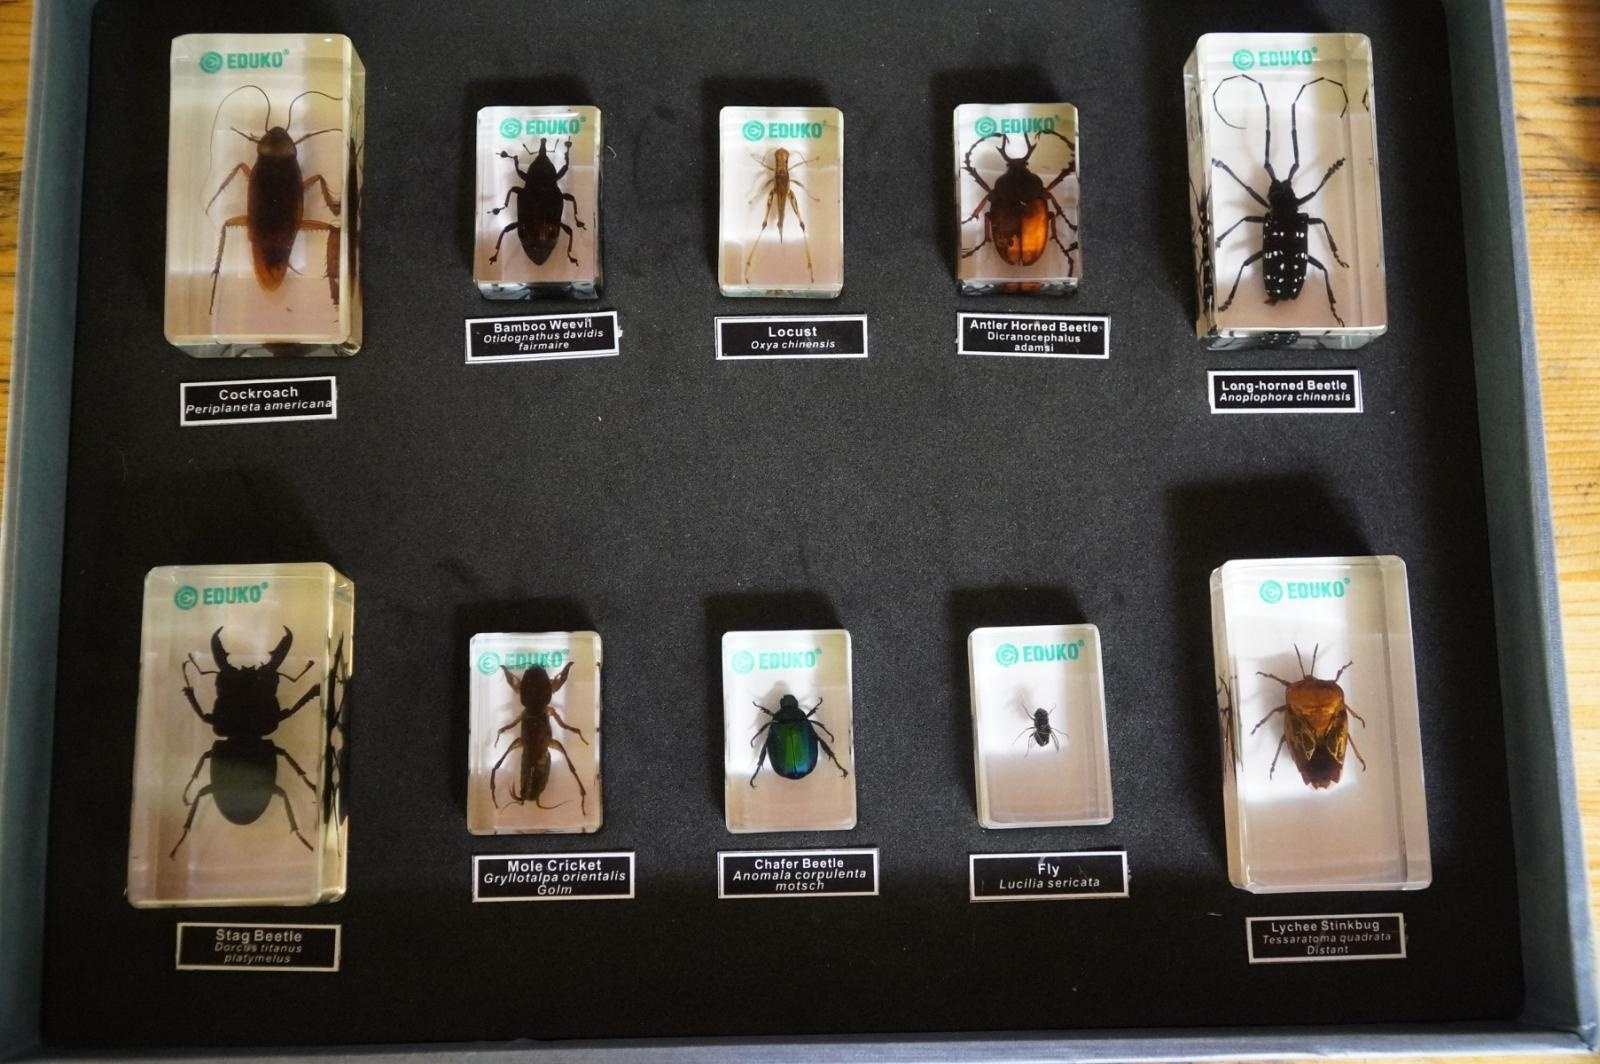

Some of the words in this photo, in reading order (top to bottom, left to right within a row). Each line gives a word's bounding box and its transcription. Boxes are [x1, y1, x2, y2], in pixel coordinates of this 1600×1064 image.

[227, 52, 283, 69] EDUKO
[1258, 49, 1312, 67] EDUKO
[526, 119, 580, 135] EDUKO
[768, 122, 822, 138] EDUKO
[1001, 117, 1055, 134] EDUKO
[493, 322, 547, 333] Bamboo
[549, 318, 592, 330] Weevil
[768, 326, 817, 337] Locust
[970, 319, 1008, 330] Antler
[1011, 320, 1056, 331] Horned
[1059, 321, 1098, 333] Beetle
[483, 330, 560, 344] Otidognathus
[563, 329, 604, 339] davidis
[987, 331, 1081, 343] Dicranocephalus
[518, 341, 569, 351] fairmaire
[751, 340, 779, 350] Oxya
[781, 339, 835, 349] chinensis
[1014, 343, 1054, 352] adamsi
[219, 386, 299, 400] Cockroach
[1222, 380, 1304, 392] Long-horned
[1307, 380, 1347, 390] Beetle
[1219, 392, 1293, 403] Anoplophora
[1296, 391, 1351, 401] chinensis
[185, 402, 261, 415] Periplaneta
[264, 399, 332, 411] americana
[203, 585, 261, 605] EDUKO
[1287, 580, 1344, 600] EDUKO
[1023, 643, 1079, 662] EDUKO
[505, 651, 563, 669] EDUKO
[759, 651, 816, 669] EDUKO
[507, 860, 543, 872] Mole
[547, 859, 602, 871] Cricket
[754, 859, 799, 869] Chafer
[802, 858, 844, 868] Beetle
[1037, 863, 1060, 877] Fly
[484, 872, 559, 886] Gryllotalpa
[562, 871, 626, 882] orientalis
[733, 870, 791, 881] Anomala
[795, 869, 867, 882] corpulenta
[537, 884, 572, 895] Golm
[775, 880, 824, 891] motsch
[1000, 879, 1044, 889] Lucilia
[1047, 877, 1100, 888] sericata
[1271, 922, 1317, 935] Lychee
[1320, 920, 1380, 932] Stinkbug
[215, 929, 250, 944] Stag
[254, 929, 302, 942] Beetle
[1263, 934, 1336, 944] Tessaratoma
[1340, 932, 1391, 944] quadrata
[214, 942, 257, 952] Dorcus
[260, 943, 302, 953] titanus
[1307, 945, 1349, 955] Distant
[224, 953, 291, 964] platymelus
